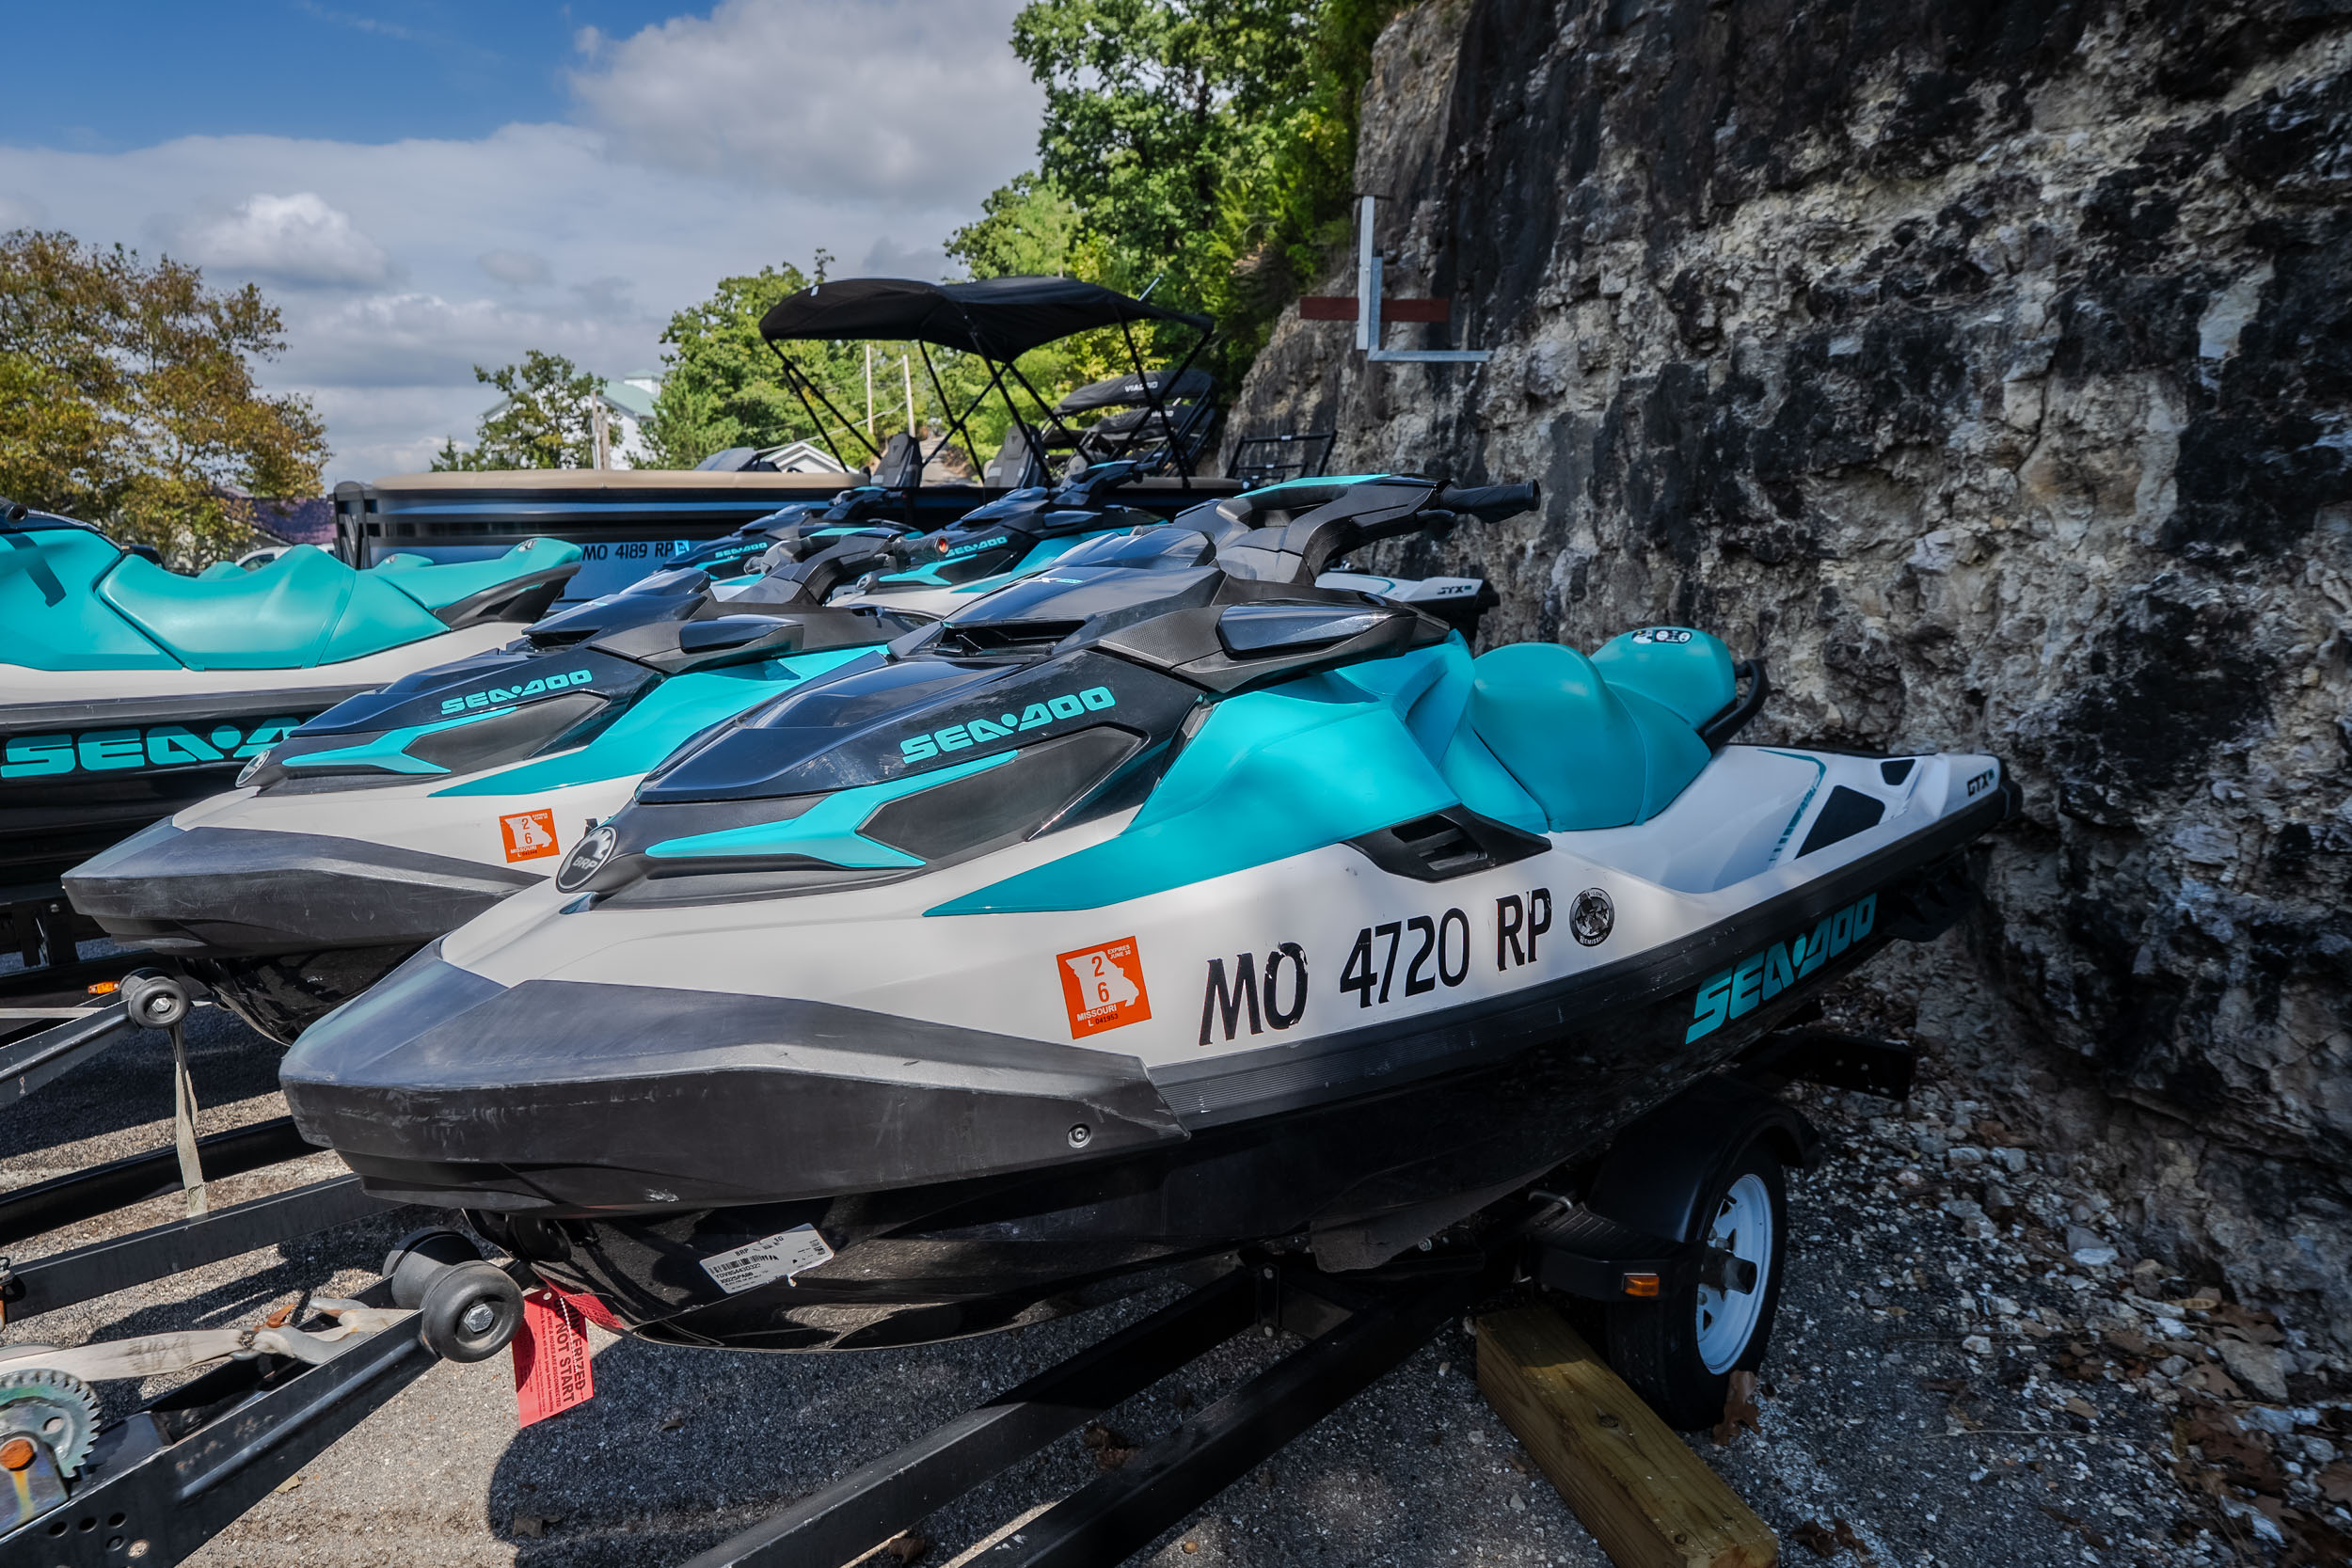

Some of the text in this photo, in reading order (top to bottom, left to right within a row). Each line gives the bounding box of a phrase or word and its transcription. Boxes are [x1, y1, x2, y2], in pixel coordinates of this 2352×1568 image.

[582, 545, 608, 562] MO
[615, 543, 647, 560] 4189
[655, 542, 674, 558] RP
[572, 856, 598, 870] BRP
[1107, 944, 1131, 955] EXPIRES
[1091, 956, 1104, 977] 2
[1199, 887, 1552, 1047] MO 4720 RP
[1097, 982, 1110, 1003] 6
[1076, 1004, 1117, 1022] MISSOURI
[1095, 1013, 1119, 1024] 041953
[735, 1247, 749, 1257] BRP
[556, 1323, 569, 1352] NOT
[560, 1356, 575, 1402] START
